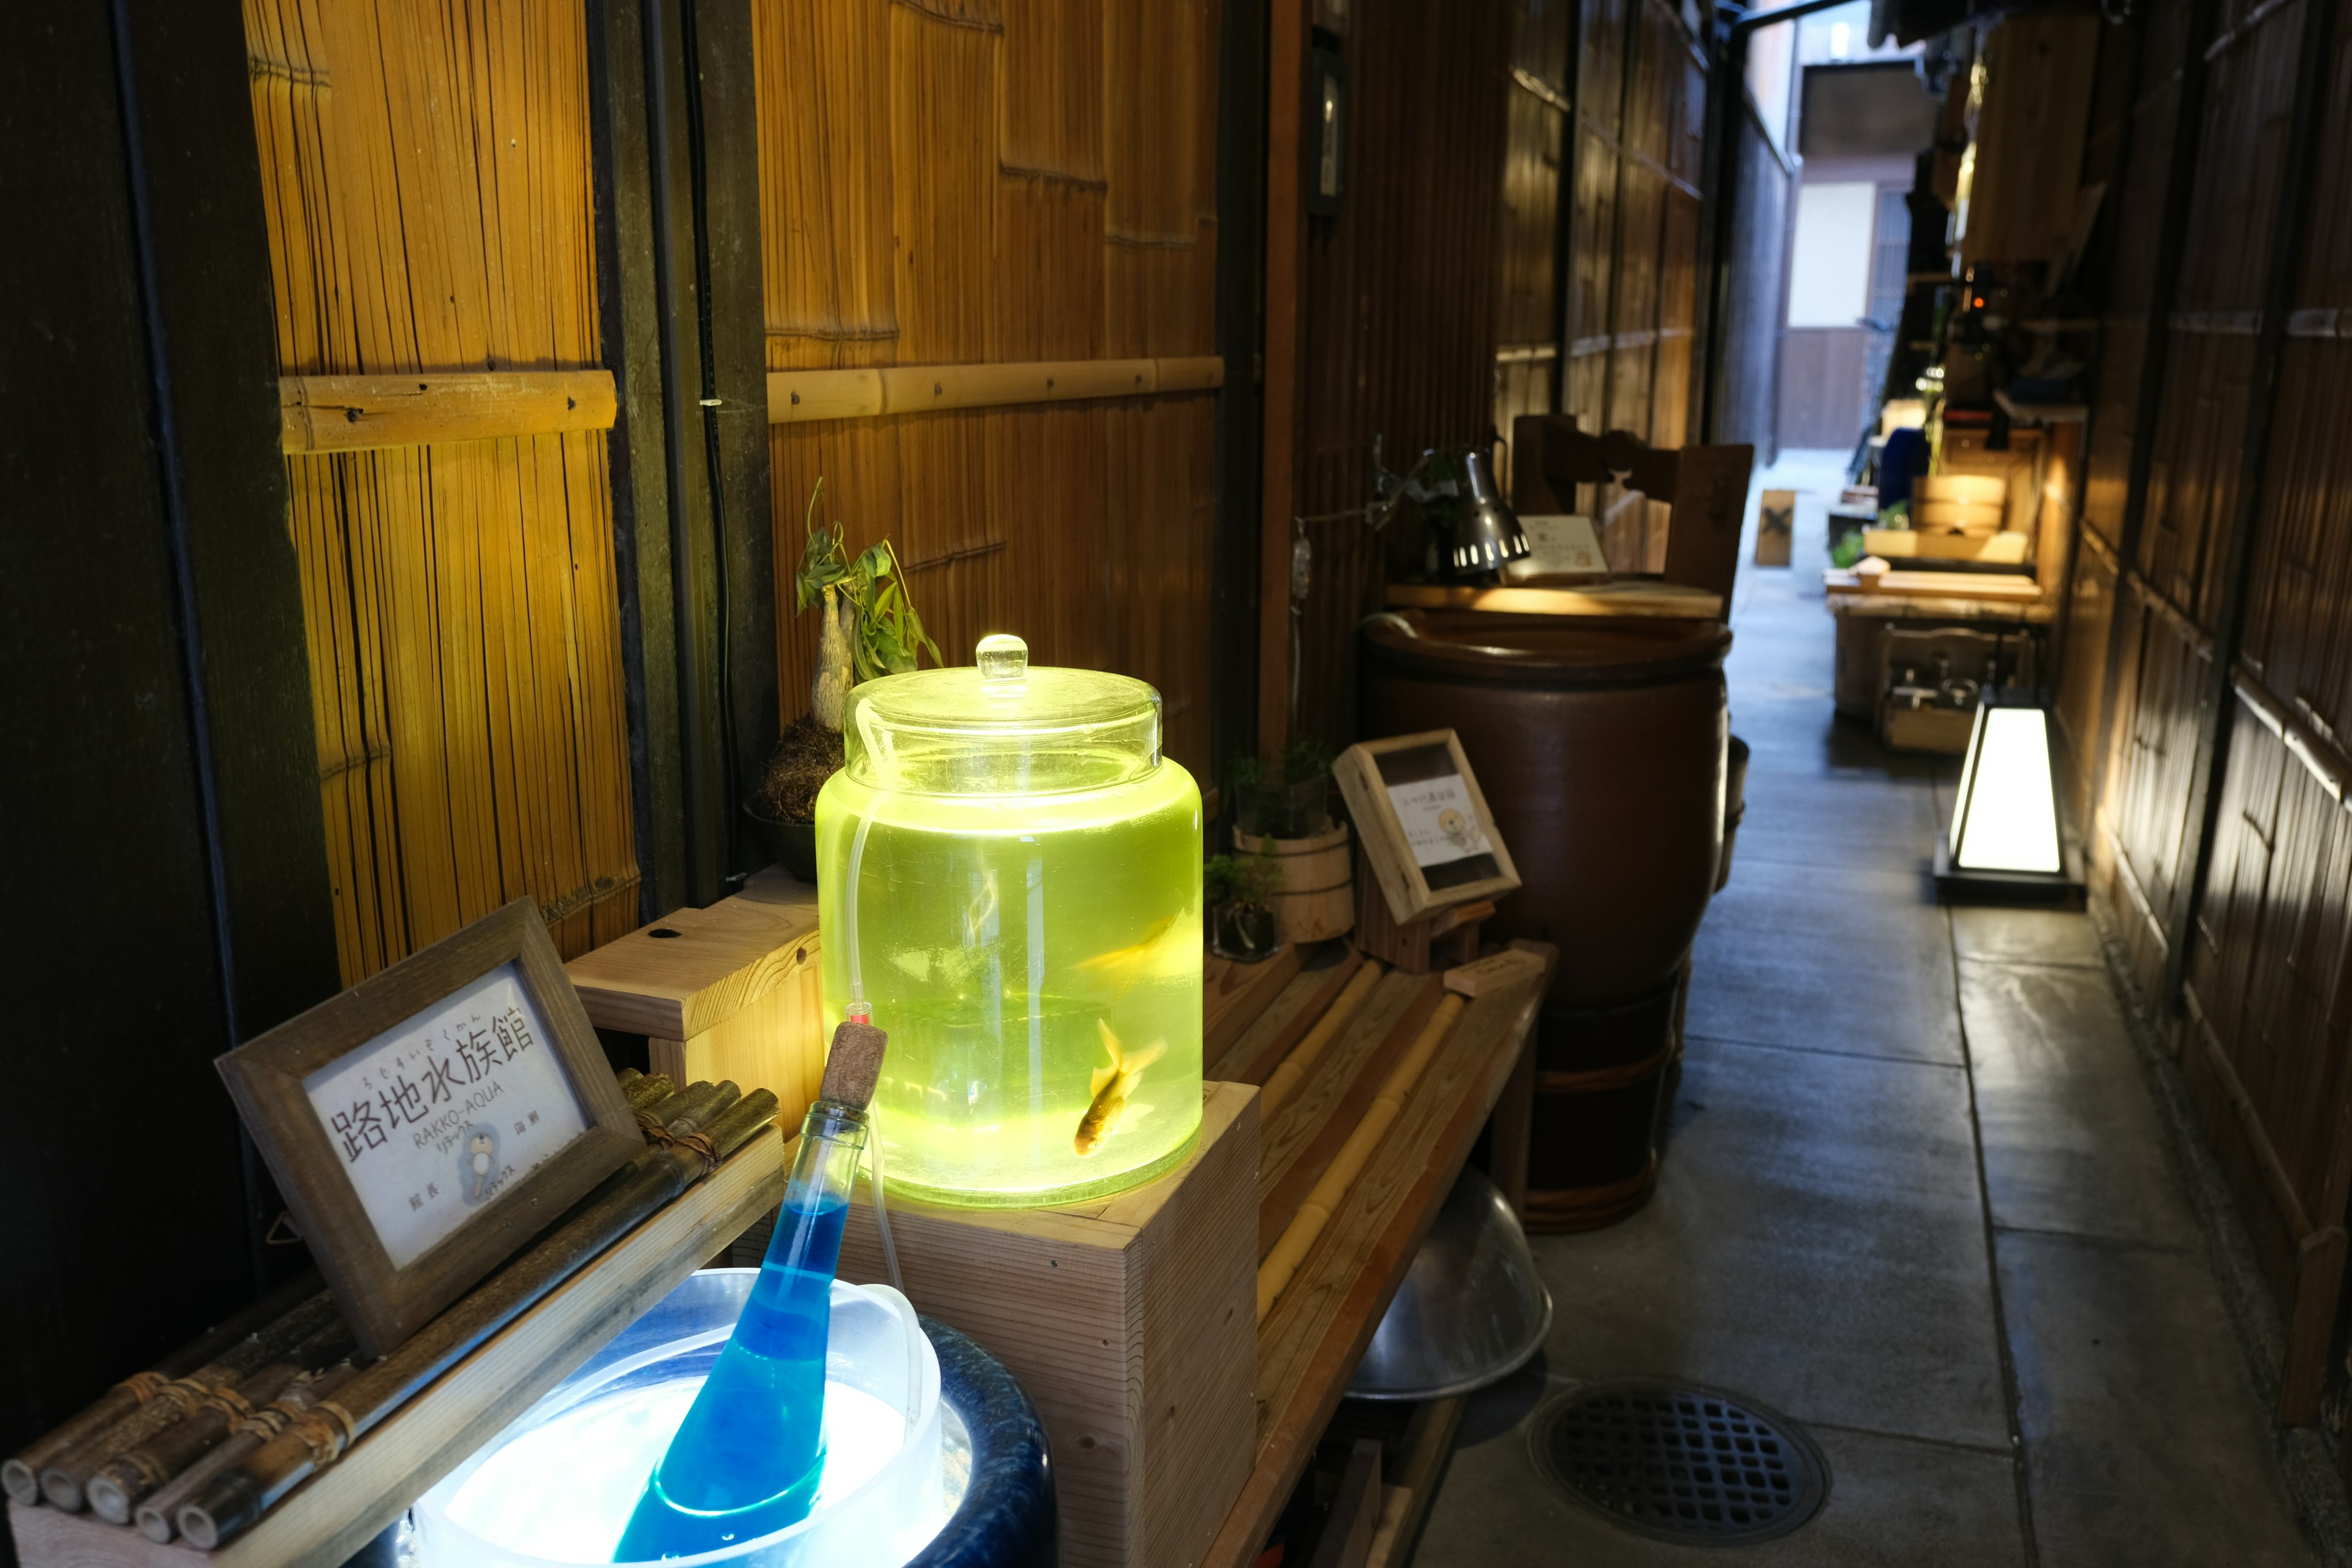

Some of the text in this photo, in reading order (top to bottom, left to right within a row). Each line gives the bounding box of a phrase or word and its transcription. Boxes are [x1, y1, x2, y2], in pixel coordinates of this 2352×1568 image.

[330, 1006, 534, 1163] 路地水族館
[413, 1080, 505, 1150] RAKKO-AQUA
[436, 1121, 475, 1155] リラックス
[484, 1165, 516, 1198] リラックス
